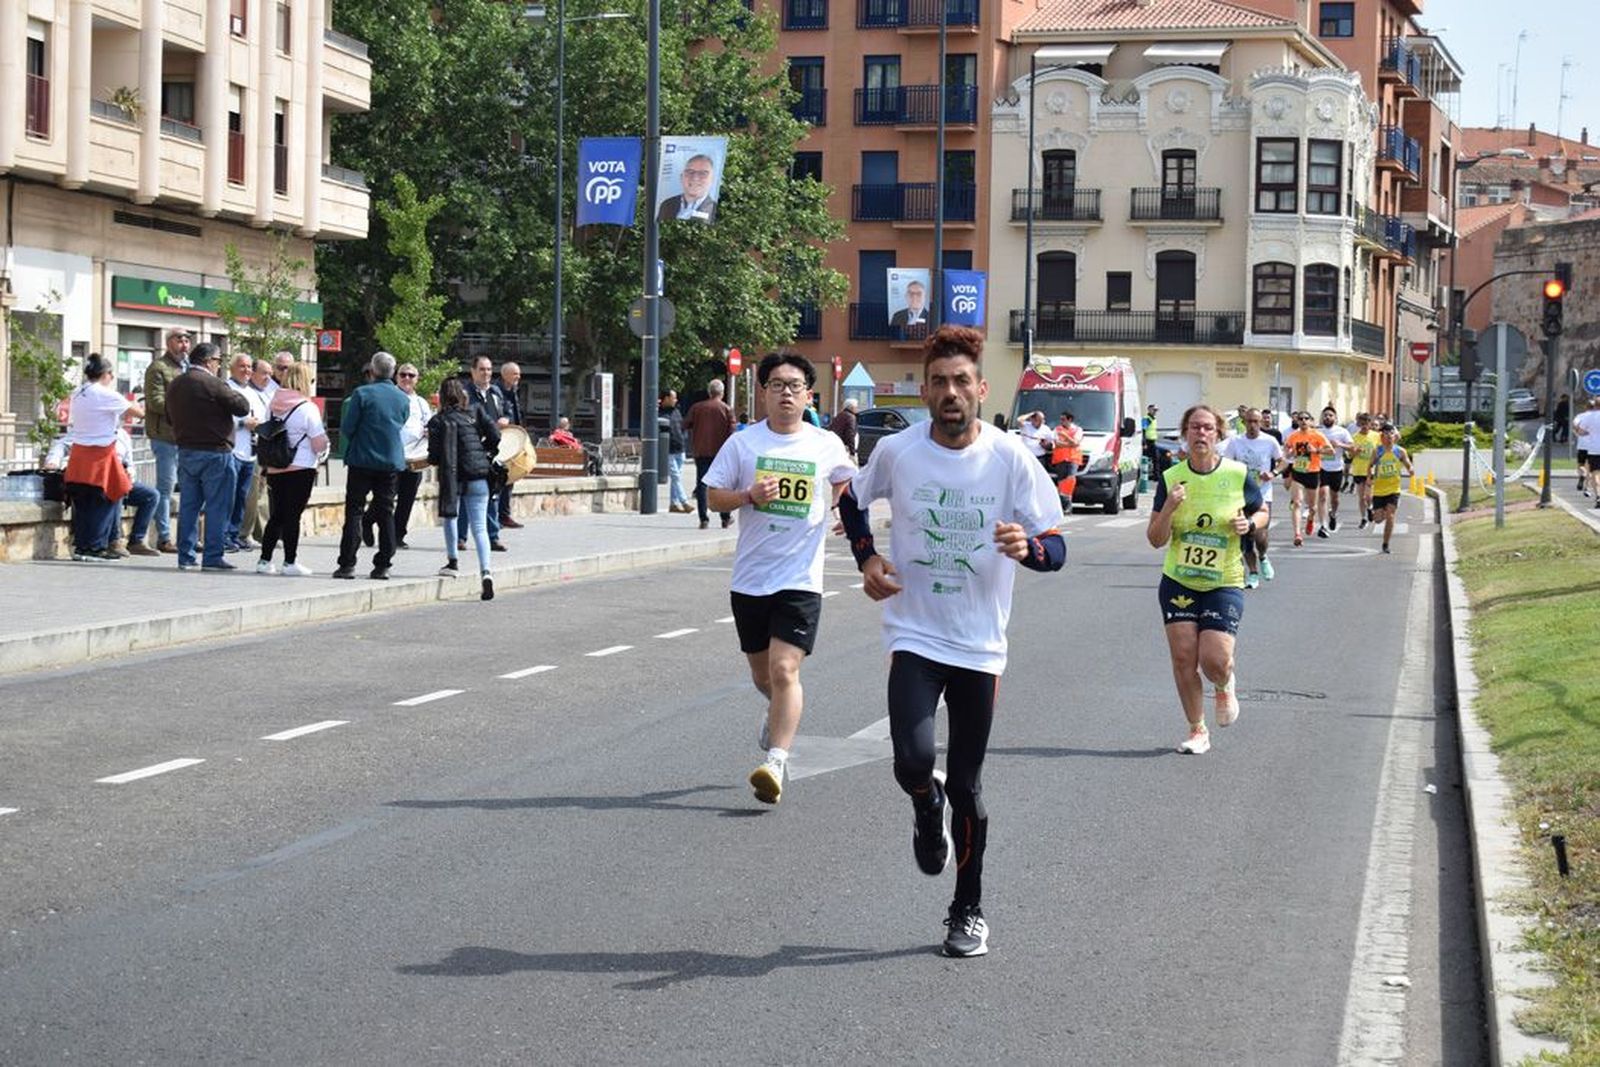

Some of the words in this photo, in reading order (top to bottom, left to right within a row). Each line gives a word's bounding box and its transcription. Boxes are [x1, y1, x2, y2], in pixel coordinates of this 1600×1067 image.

[588, 161, 625, 173] VOTA
[952, 285, 978, 294] VOTA
[1184, 546, 1217, 567] 132
